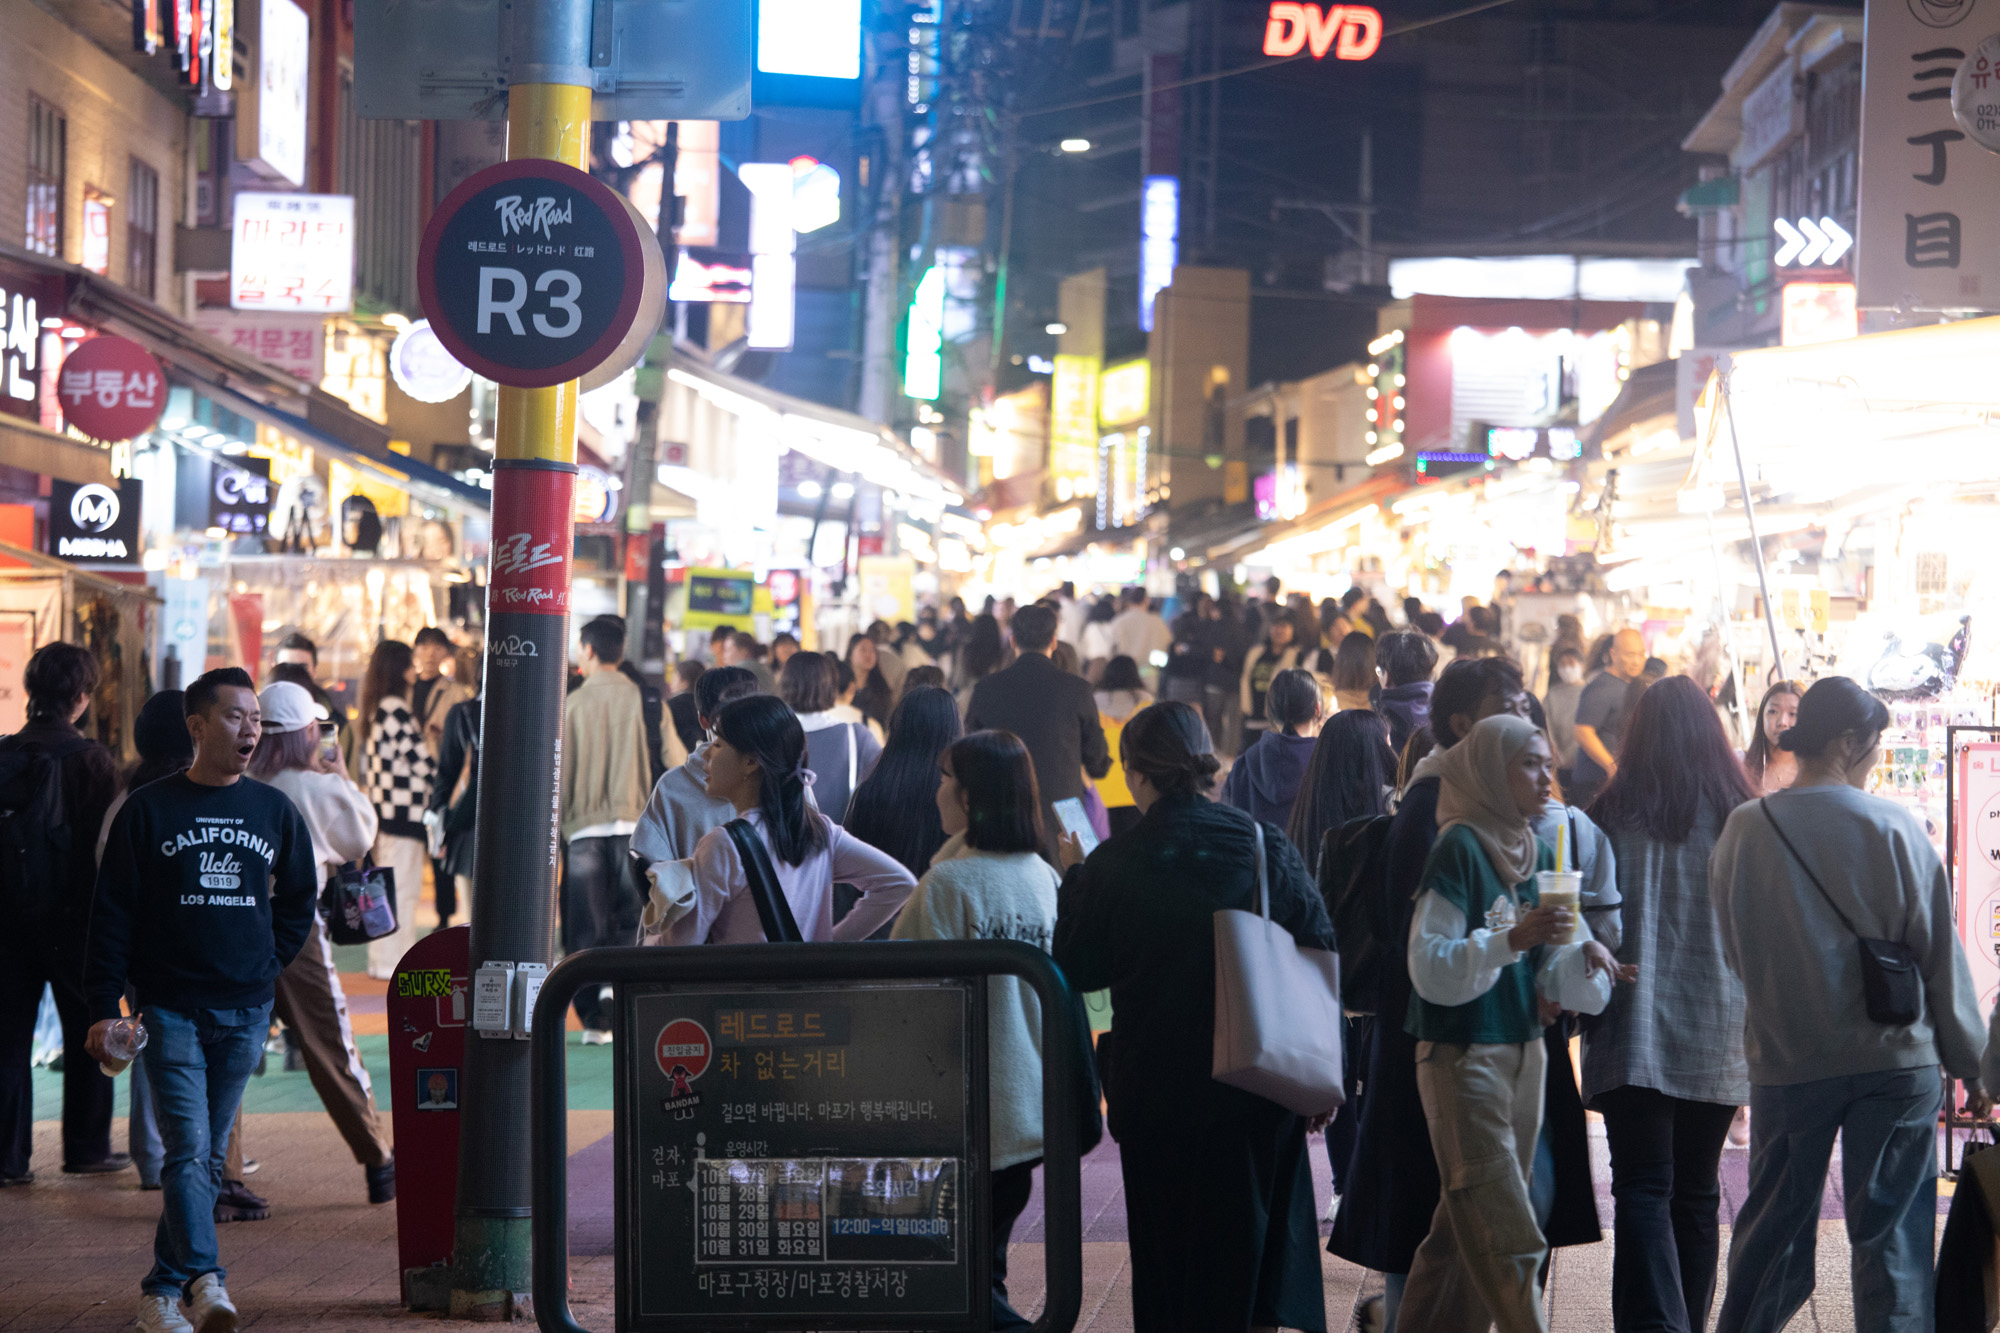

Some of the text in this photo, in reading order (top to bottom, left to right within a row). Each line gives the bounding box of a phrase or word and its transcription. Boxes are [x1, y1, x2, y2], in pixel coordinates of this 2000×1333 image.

[1263, 1, 1383, 61] DVD
[1905, 48, 1965, 269] 三丁目
[494, 195, 572, 241] Red Road
[468, 240, 507, 253] 레드로드
[477, 266, 583, 339] R3
[63, 371, 158, 408] 부동산
[196, 817, 233, 825] UNIVERSITY
[161, 827, 275, 865] CALIFORNIA
[207, 876, 232, 887] 1919
[180, 894, 256, 907] LOS ANGELES
[719, 1011, 826, 1043] 레드로드
[720, 1053, 741, 1080] 차
[664, 1095, 700, 1111] BANDAM
[721, 1100, 937, 1123] 걸으면 바뀝니다. 마포가 행복해집니다.
[726, 1140, 768, 1159] 운영시간
[651, 1170, 681, 1190] 마포
[701, 1168, 731, 1185] 10월
[701, 1186, 731, 1203] 10월
[738, 1186, 769, 1203] 28일
[701, 1204, 731, 1221] 10월
[738, 1204, 769, 1221] 29일
[701, 1222, 821, 1239] 10월 30일 월요일
[701, 1239, 821, 1256] 10월 31일 화요일
